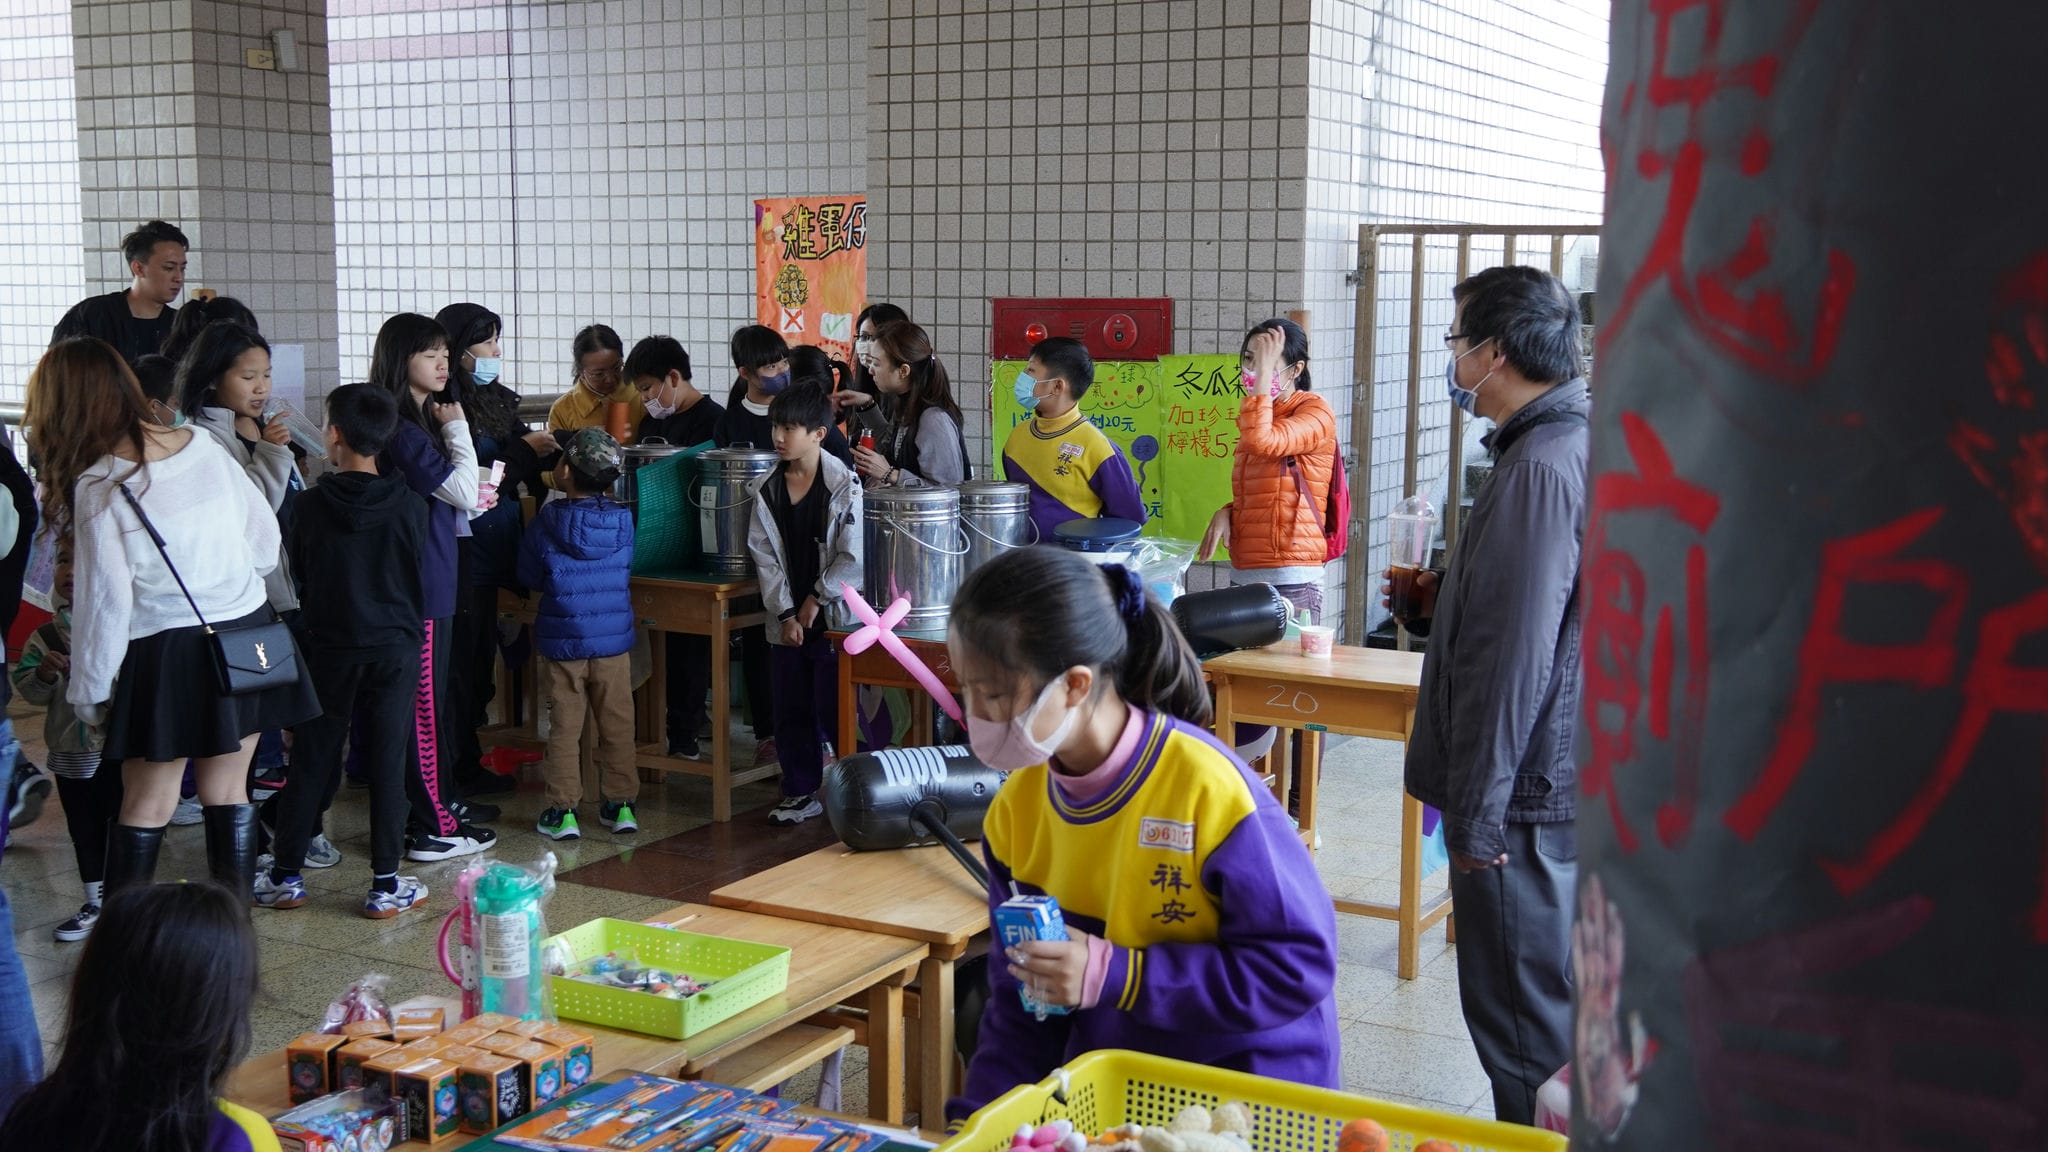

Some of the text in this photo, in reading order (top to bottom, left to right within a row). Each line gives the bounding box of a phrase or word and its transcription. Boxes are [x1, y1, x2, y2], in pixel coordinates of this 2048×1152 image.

[1266, 684, 1319, 714] 20
[871, 746, 948, 787] 1000
[1149, 863, 1197, 924] 祥安
